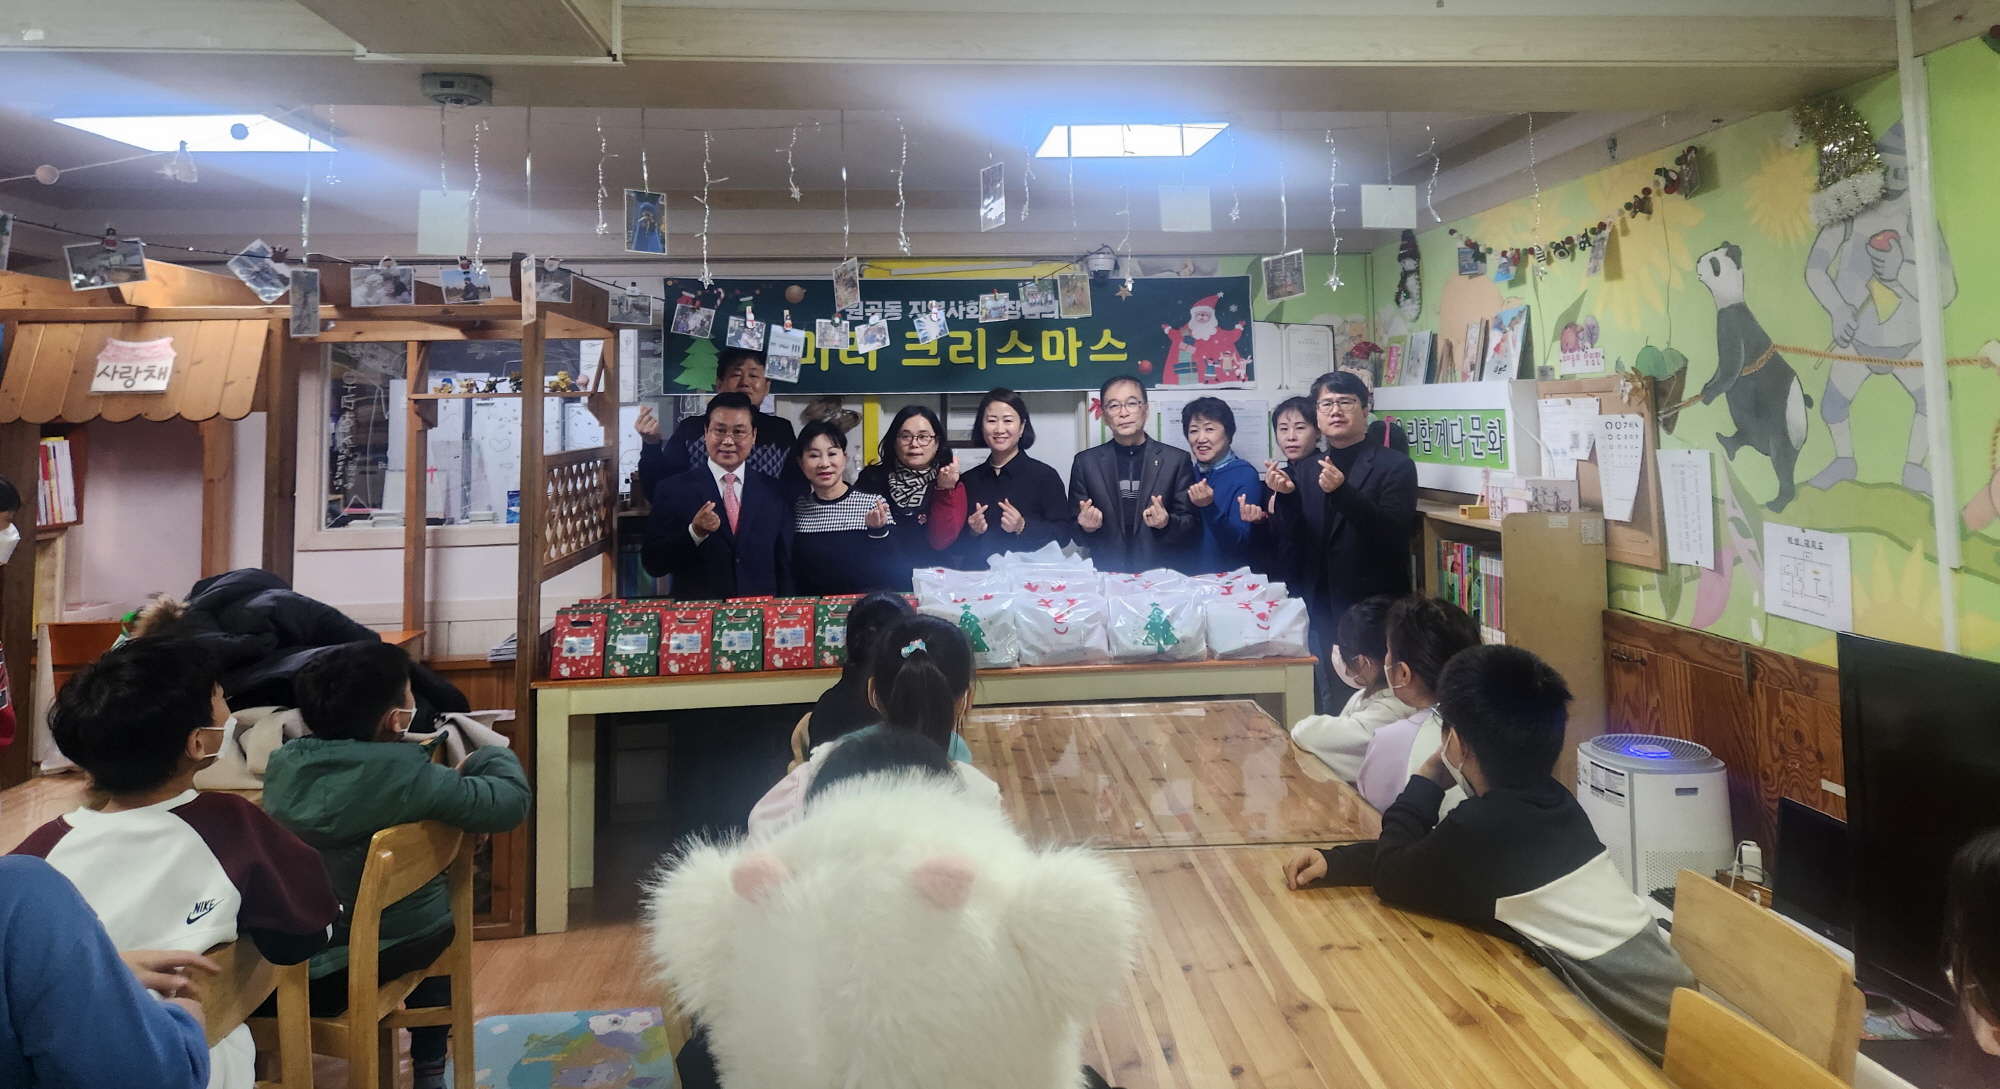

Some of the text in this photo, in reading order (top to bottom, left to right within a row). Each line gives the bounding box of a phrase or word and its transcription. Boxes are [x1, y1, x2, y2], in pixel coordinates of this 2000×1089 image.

[901, 328, 1128, 370] 크리스마스
[96, 365, 169, 389] 사랑채
[1395, 414, 1507, 464] 리함께다문화
[193, 899, 215, 914] NIKE
